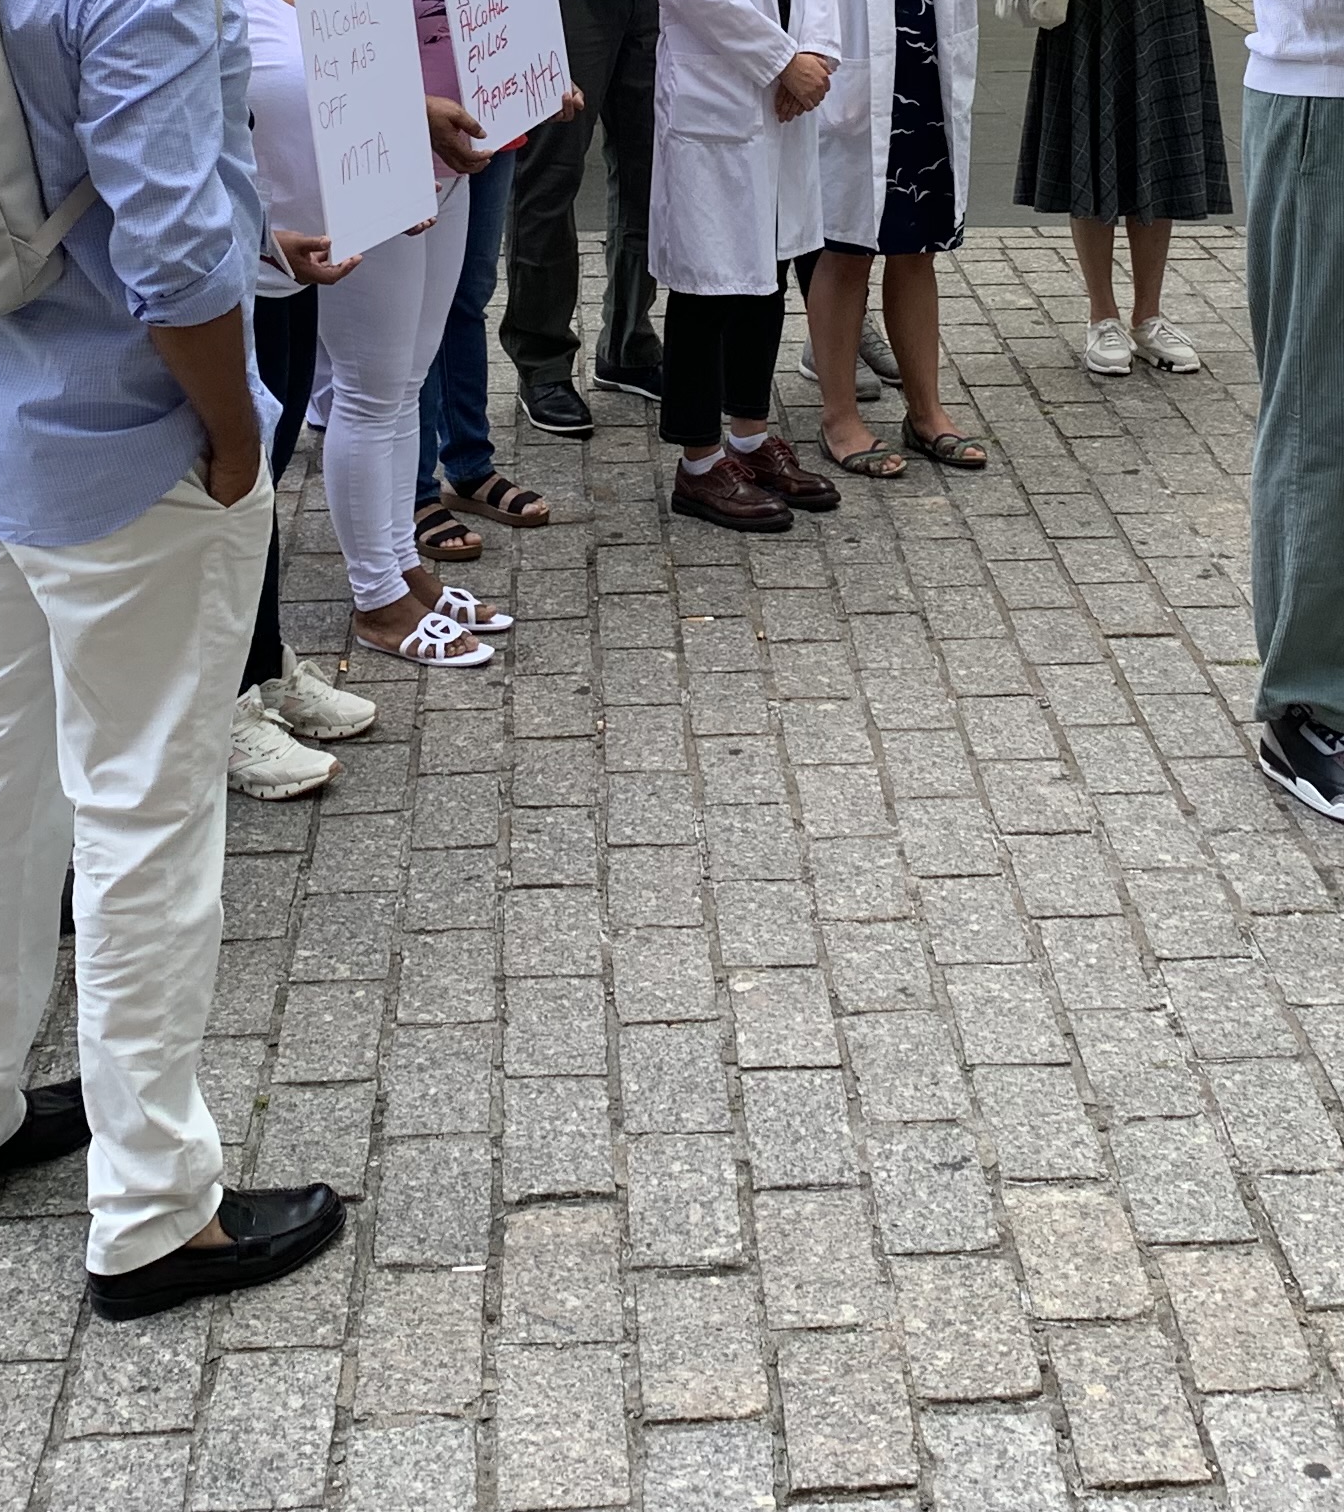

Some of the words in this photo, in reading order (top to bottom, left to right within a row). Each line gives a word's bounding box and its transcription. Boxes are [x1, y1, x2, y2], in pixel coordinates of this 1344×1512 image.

[468, 43, 485, 74] EN
[487, 24, 509, 60] LOS
[523, 50, 565, 118] MTA
[318, 93, 348, 130] OFF
[341, 131, 391, 186] MTA
